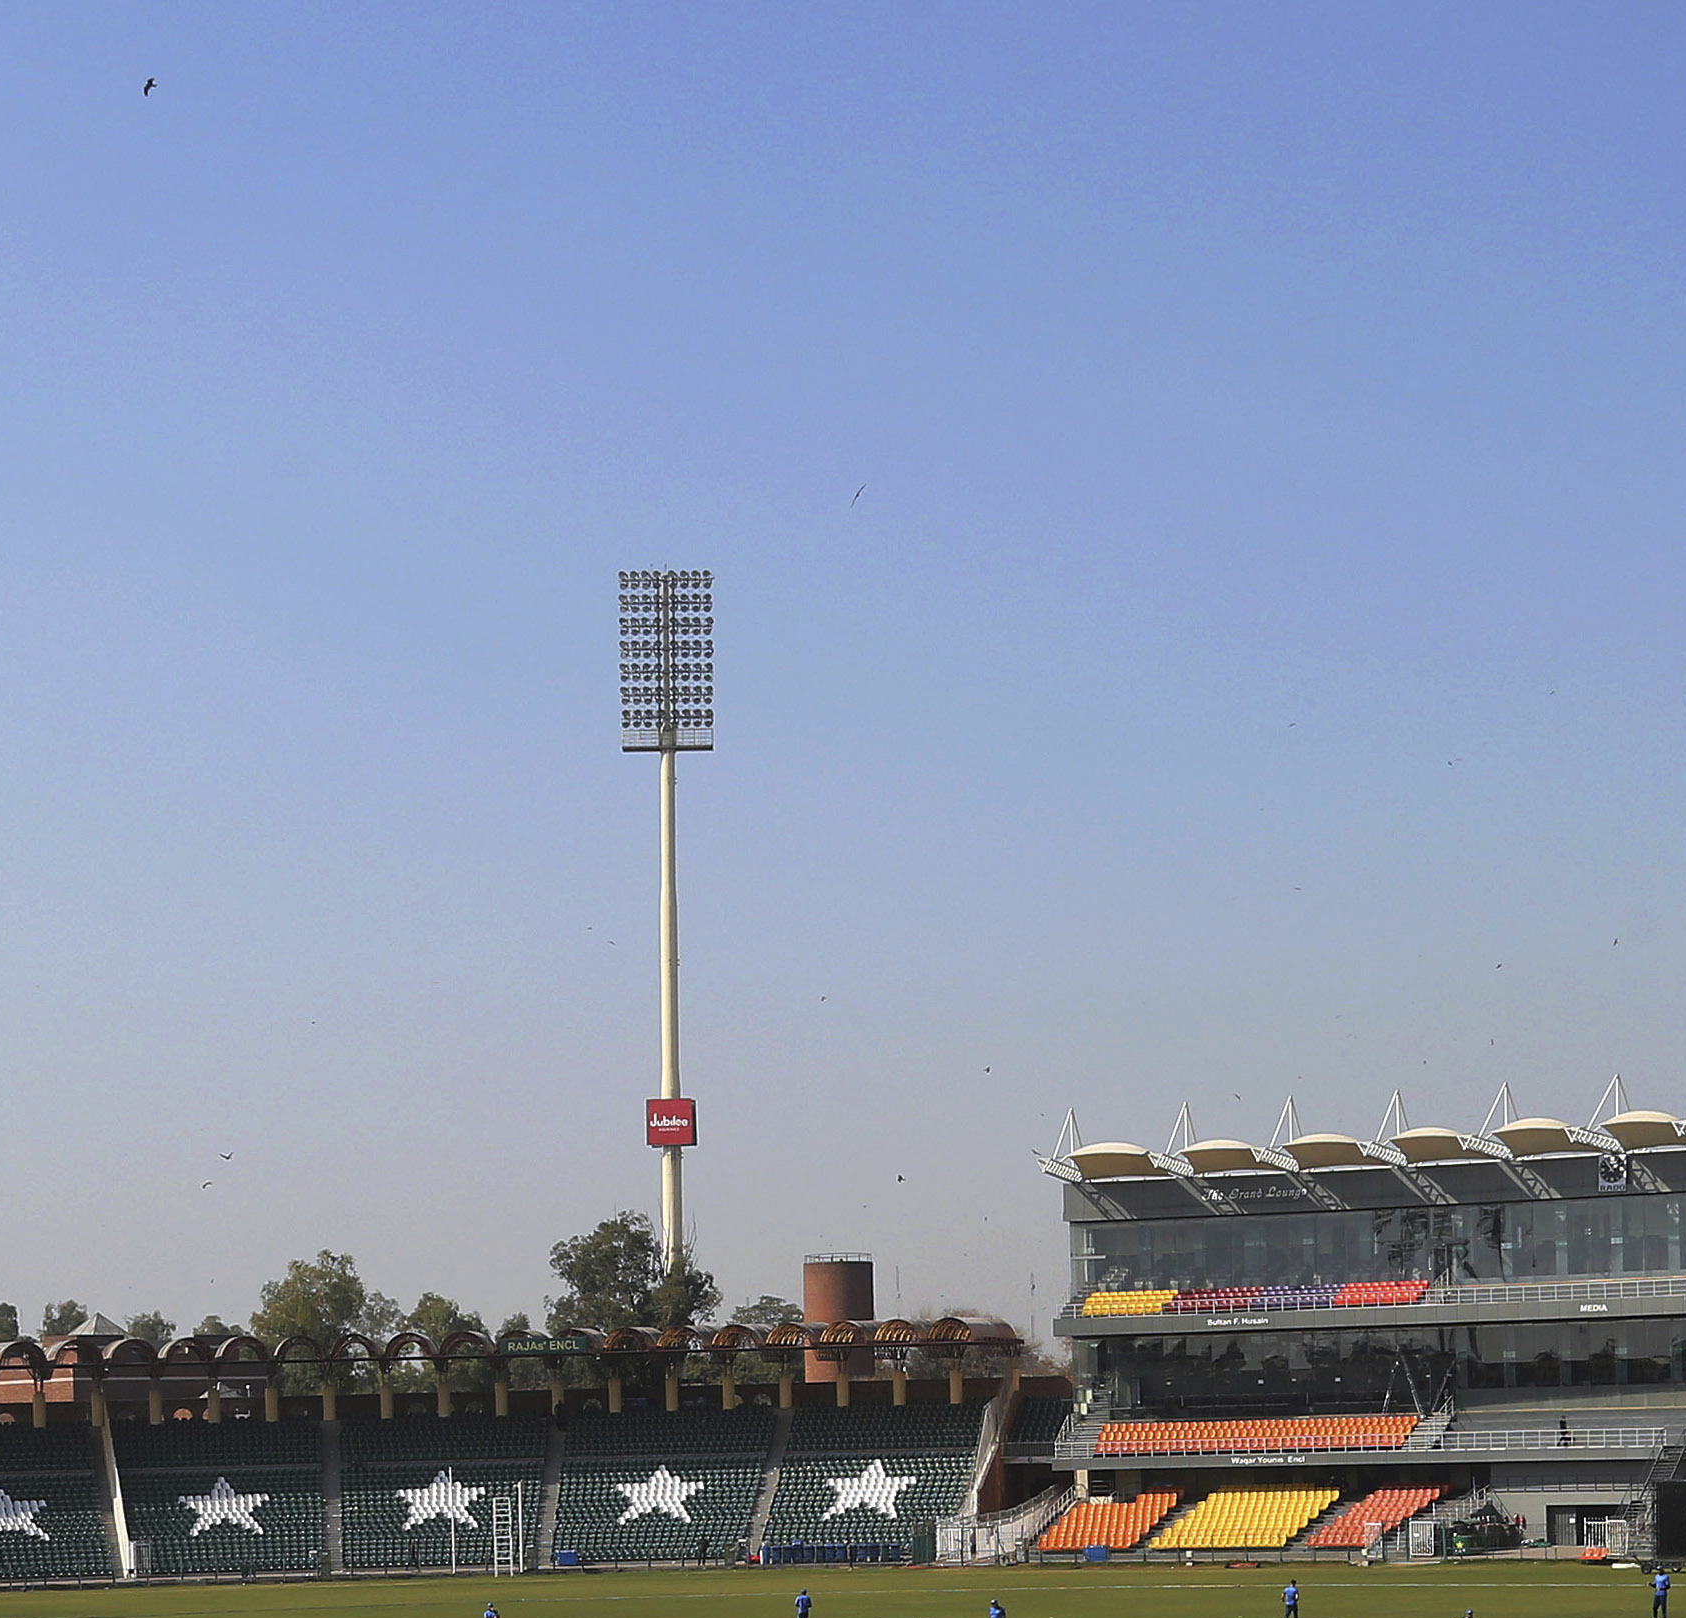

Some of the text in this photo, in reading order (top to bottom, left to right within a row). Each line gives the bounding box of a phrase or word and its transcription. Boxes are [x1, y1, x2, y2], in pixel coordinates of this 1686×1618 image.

[1201, 1186, 1307, 1201] The Grand Lounge
[1580, 1304, 1608, 1312] MEDIA
[549, 1340, 580, 1350] ENCL
[1231, 1457, 1256, 1465] Waqar
[1287, 1455, 1306, 1463] Encl
